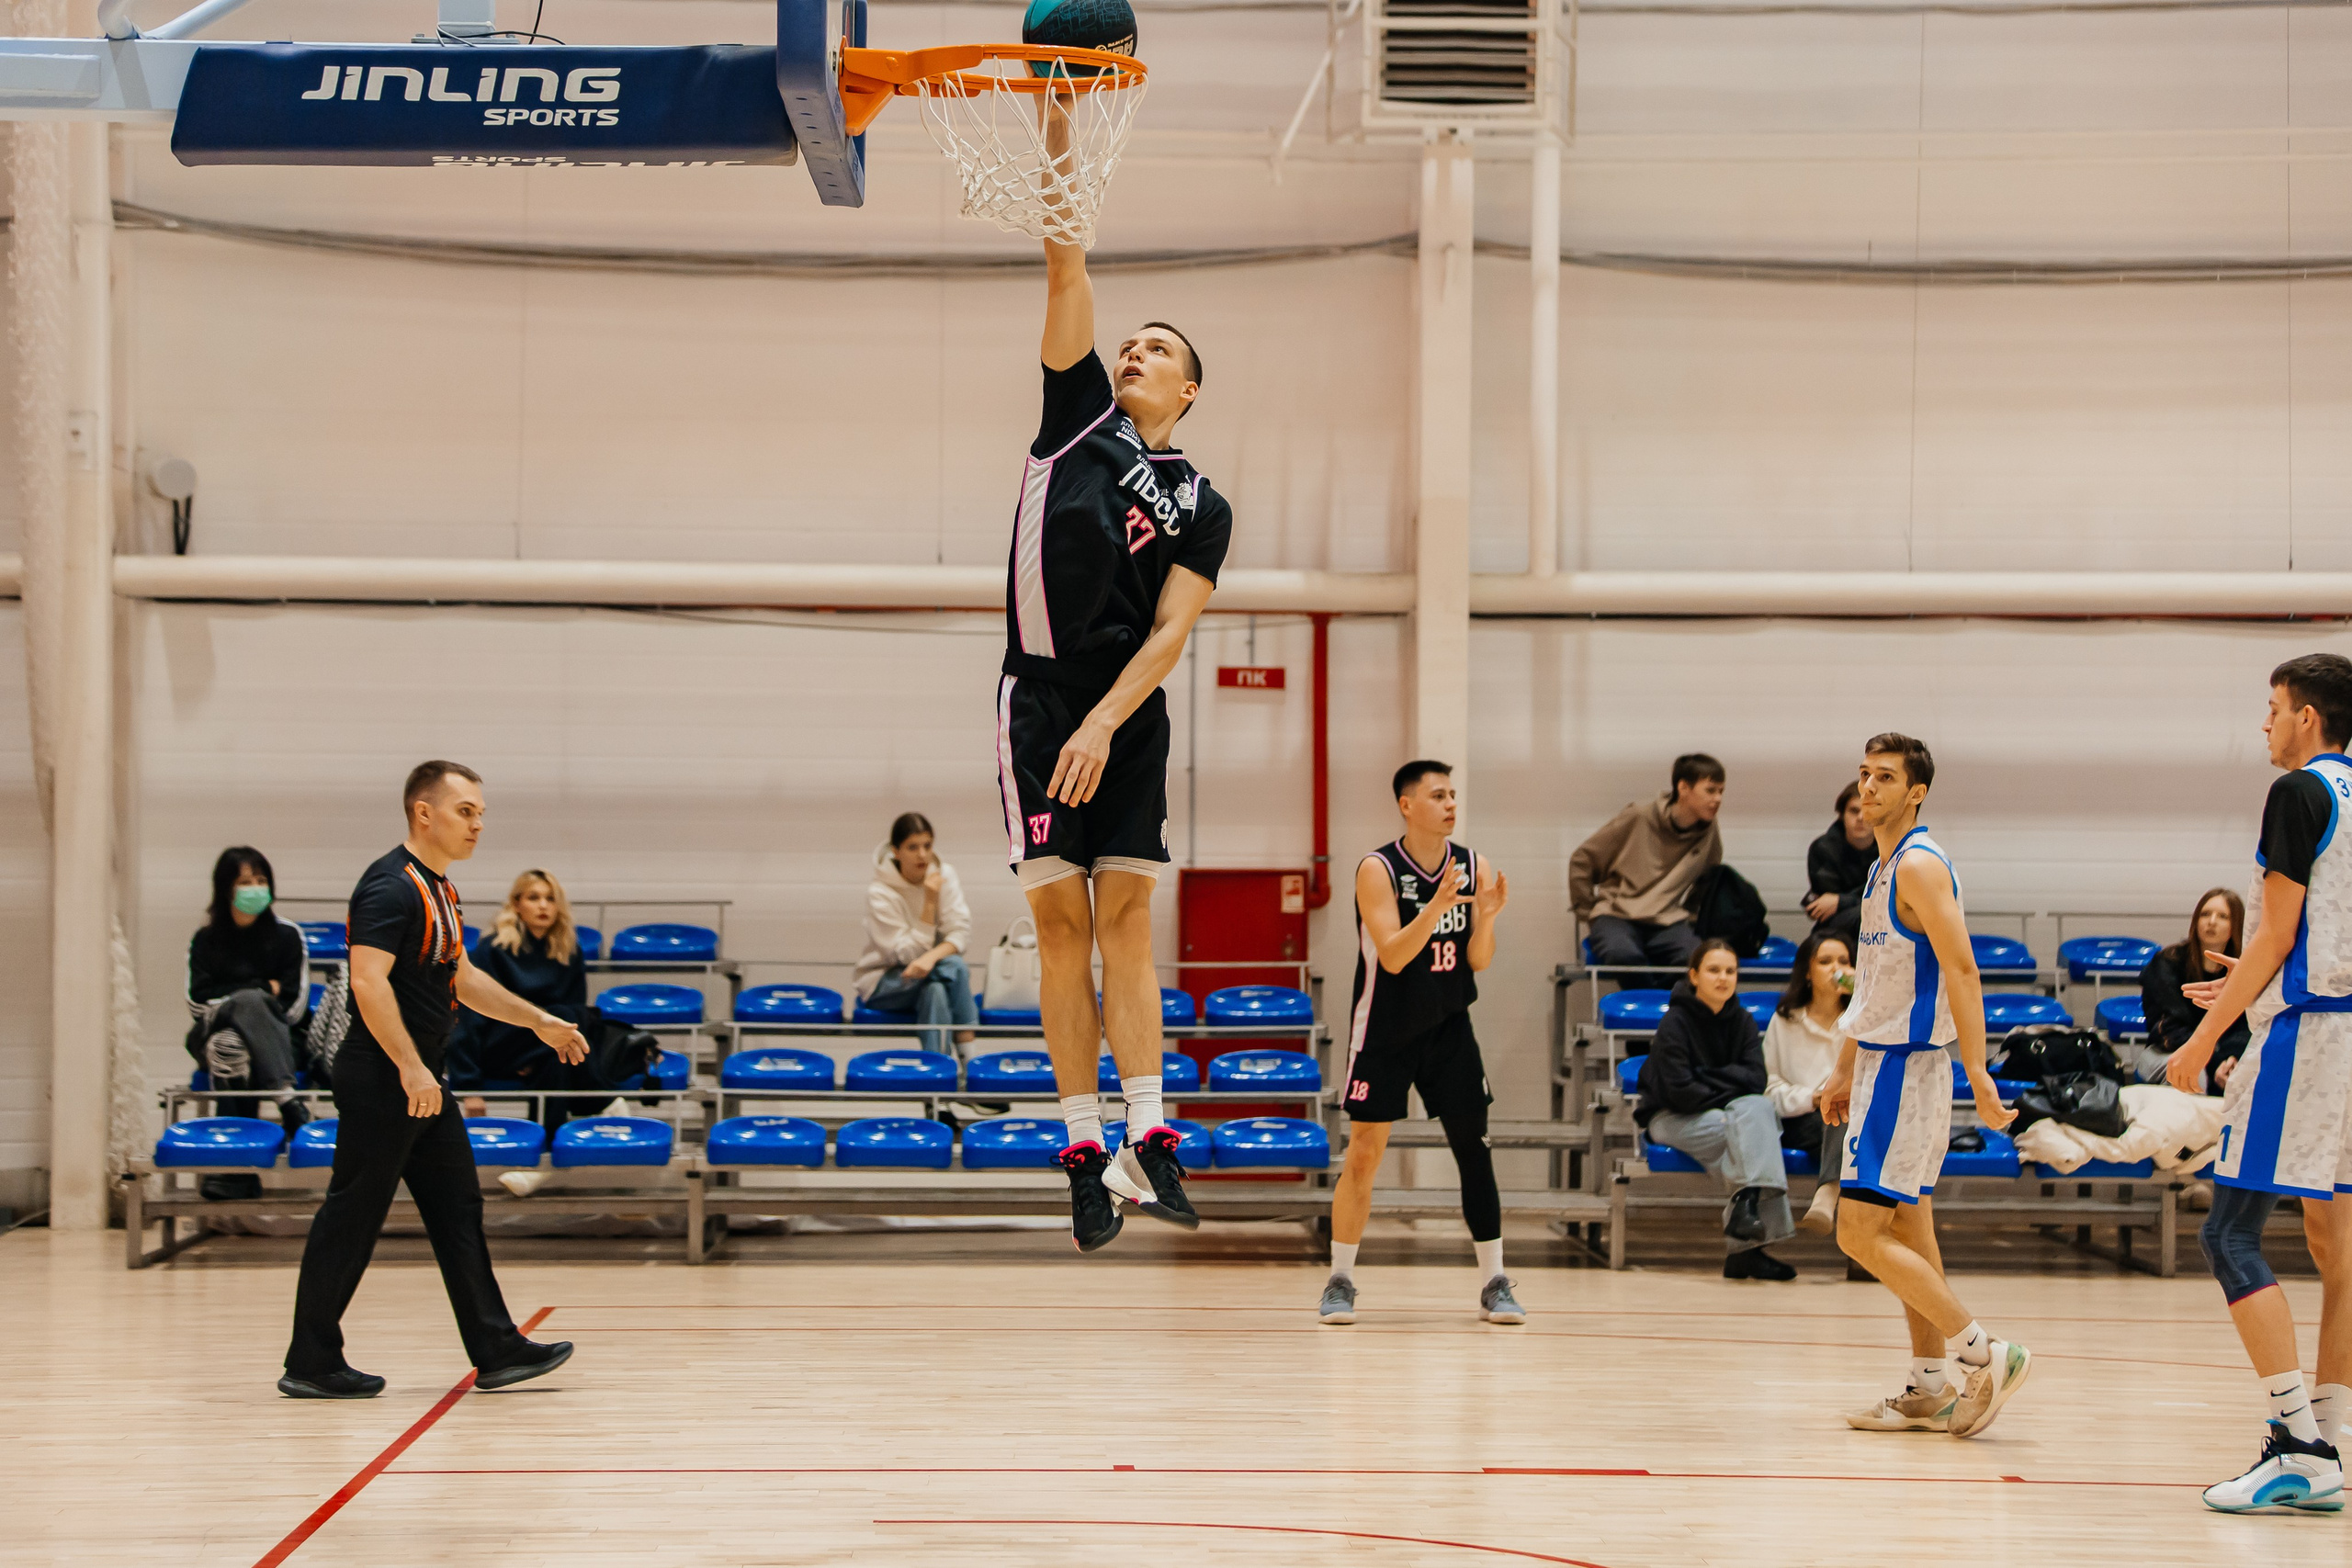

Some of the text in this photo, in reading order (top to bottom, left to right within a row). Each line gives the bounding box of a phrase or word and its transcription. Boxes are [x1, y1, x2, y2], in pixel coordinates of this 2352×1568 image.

[301, 65, 622, 103] JINLING
[483, 108, 620, 126] SPORTS
[1237, 670, 1267, 685] ПК
[1027, 812, 1052, 846] 37
[1430, 940, 1456, 972] 18
[1349, 1079, 1370, 1101] 18
[2219, 1124, 2233, 1163] 1
